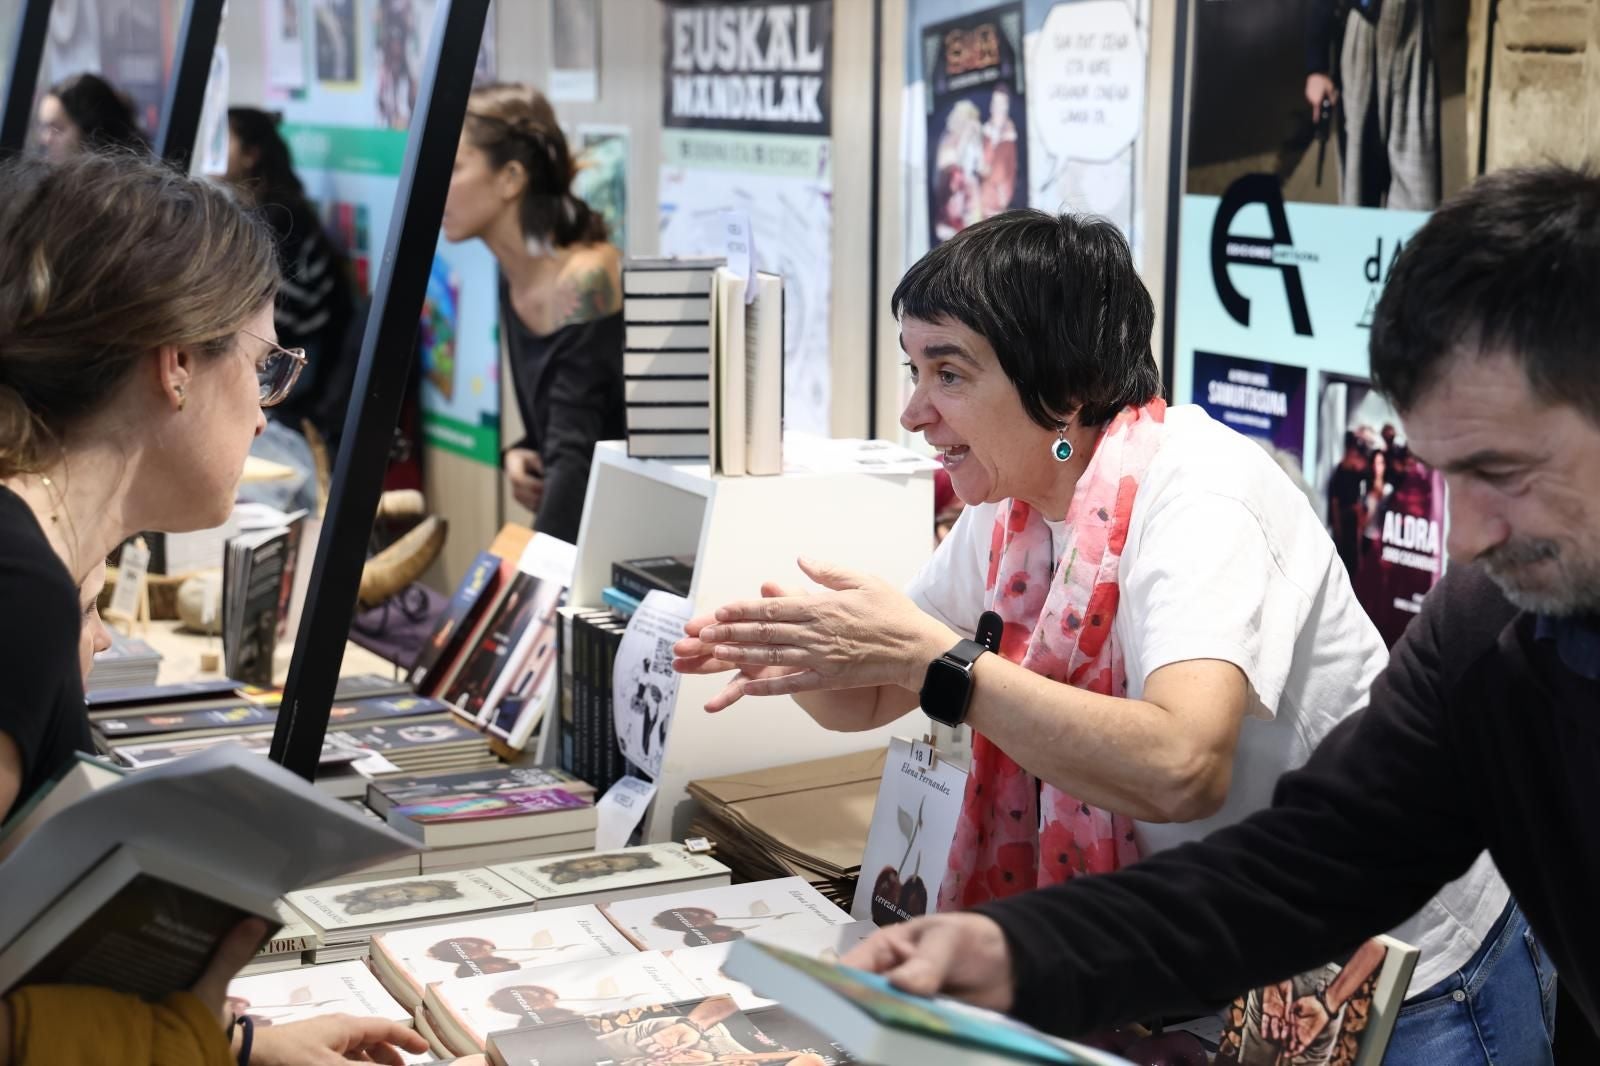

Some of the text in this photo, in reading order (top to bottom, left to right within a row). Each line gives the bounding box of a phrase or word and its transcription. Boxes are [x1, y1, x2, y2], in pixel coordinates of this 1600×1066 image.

[672, 5, 823, 72] EUSKAL
[672, 74, 823, 122] MANDALAK
[915, 750, 923, 761] 18
[901, 762, 951, 796] Elena Fernandez
[875, 895, 897, 912] cerezas
